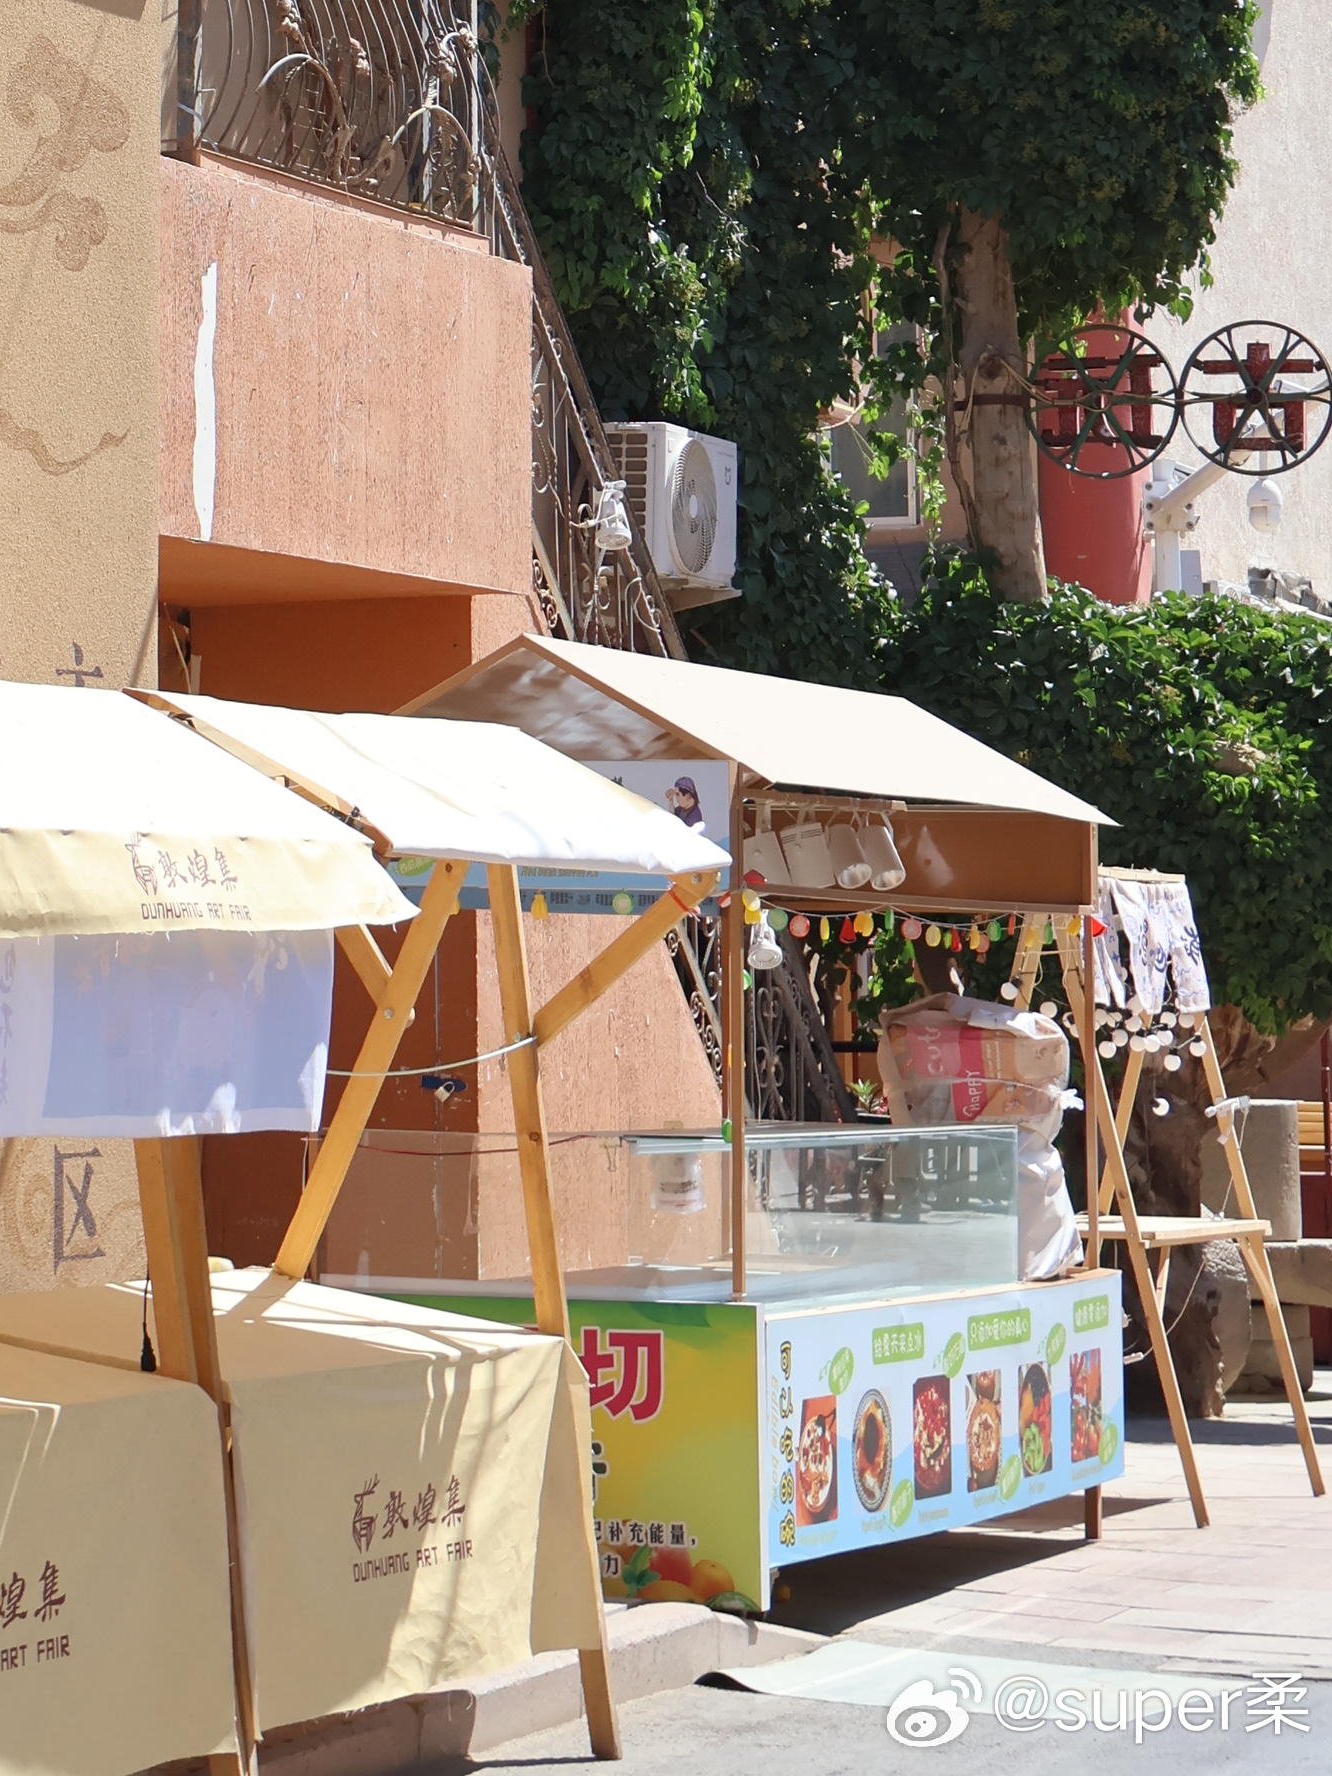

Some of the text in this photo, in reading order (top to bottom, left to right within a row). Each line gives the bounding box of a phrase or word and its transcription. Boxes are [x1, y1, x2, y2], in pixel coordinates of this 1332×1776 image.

[157, 846, 238, 892] 敦煌集
[141, 902, 252, 921] DUNHUANG ART FAIR
[52, 1144, 106, 1275] 区
[579, 1328, 663, 1422] 切
[780, 1340, 796, 1548] 可以吃的碗
[382, 1474, 466, 1540] 敦煌集
[353, 1539, 473, 1583] DUNHUANG ART FAIR
[604, 1554, 619, 1575] 力
[0, 1644, 28, 1672] ART
[36, 1634, 70, 1663] FAIR
